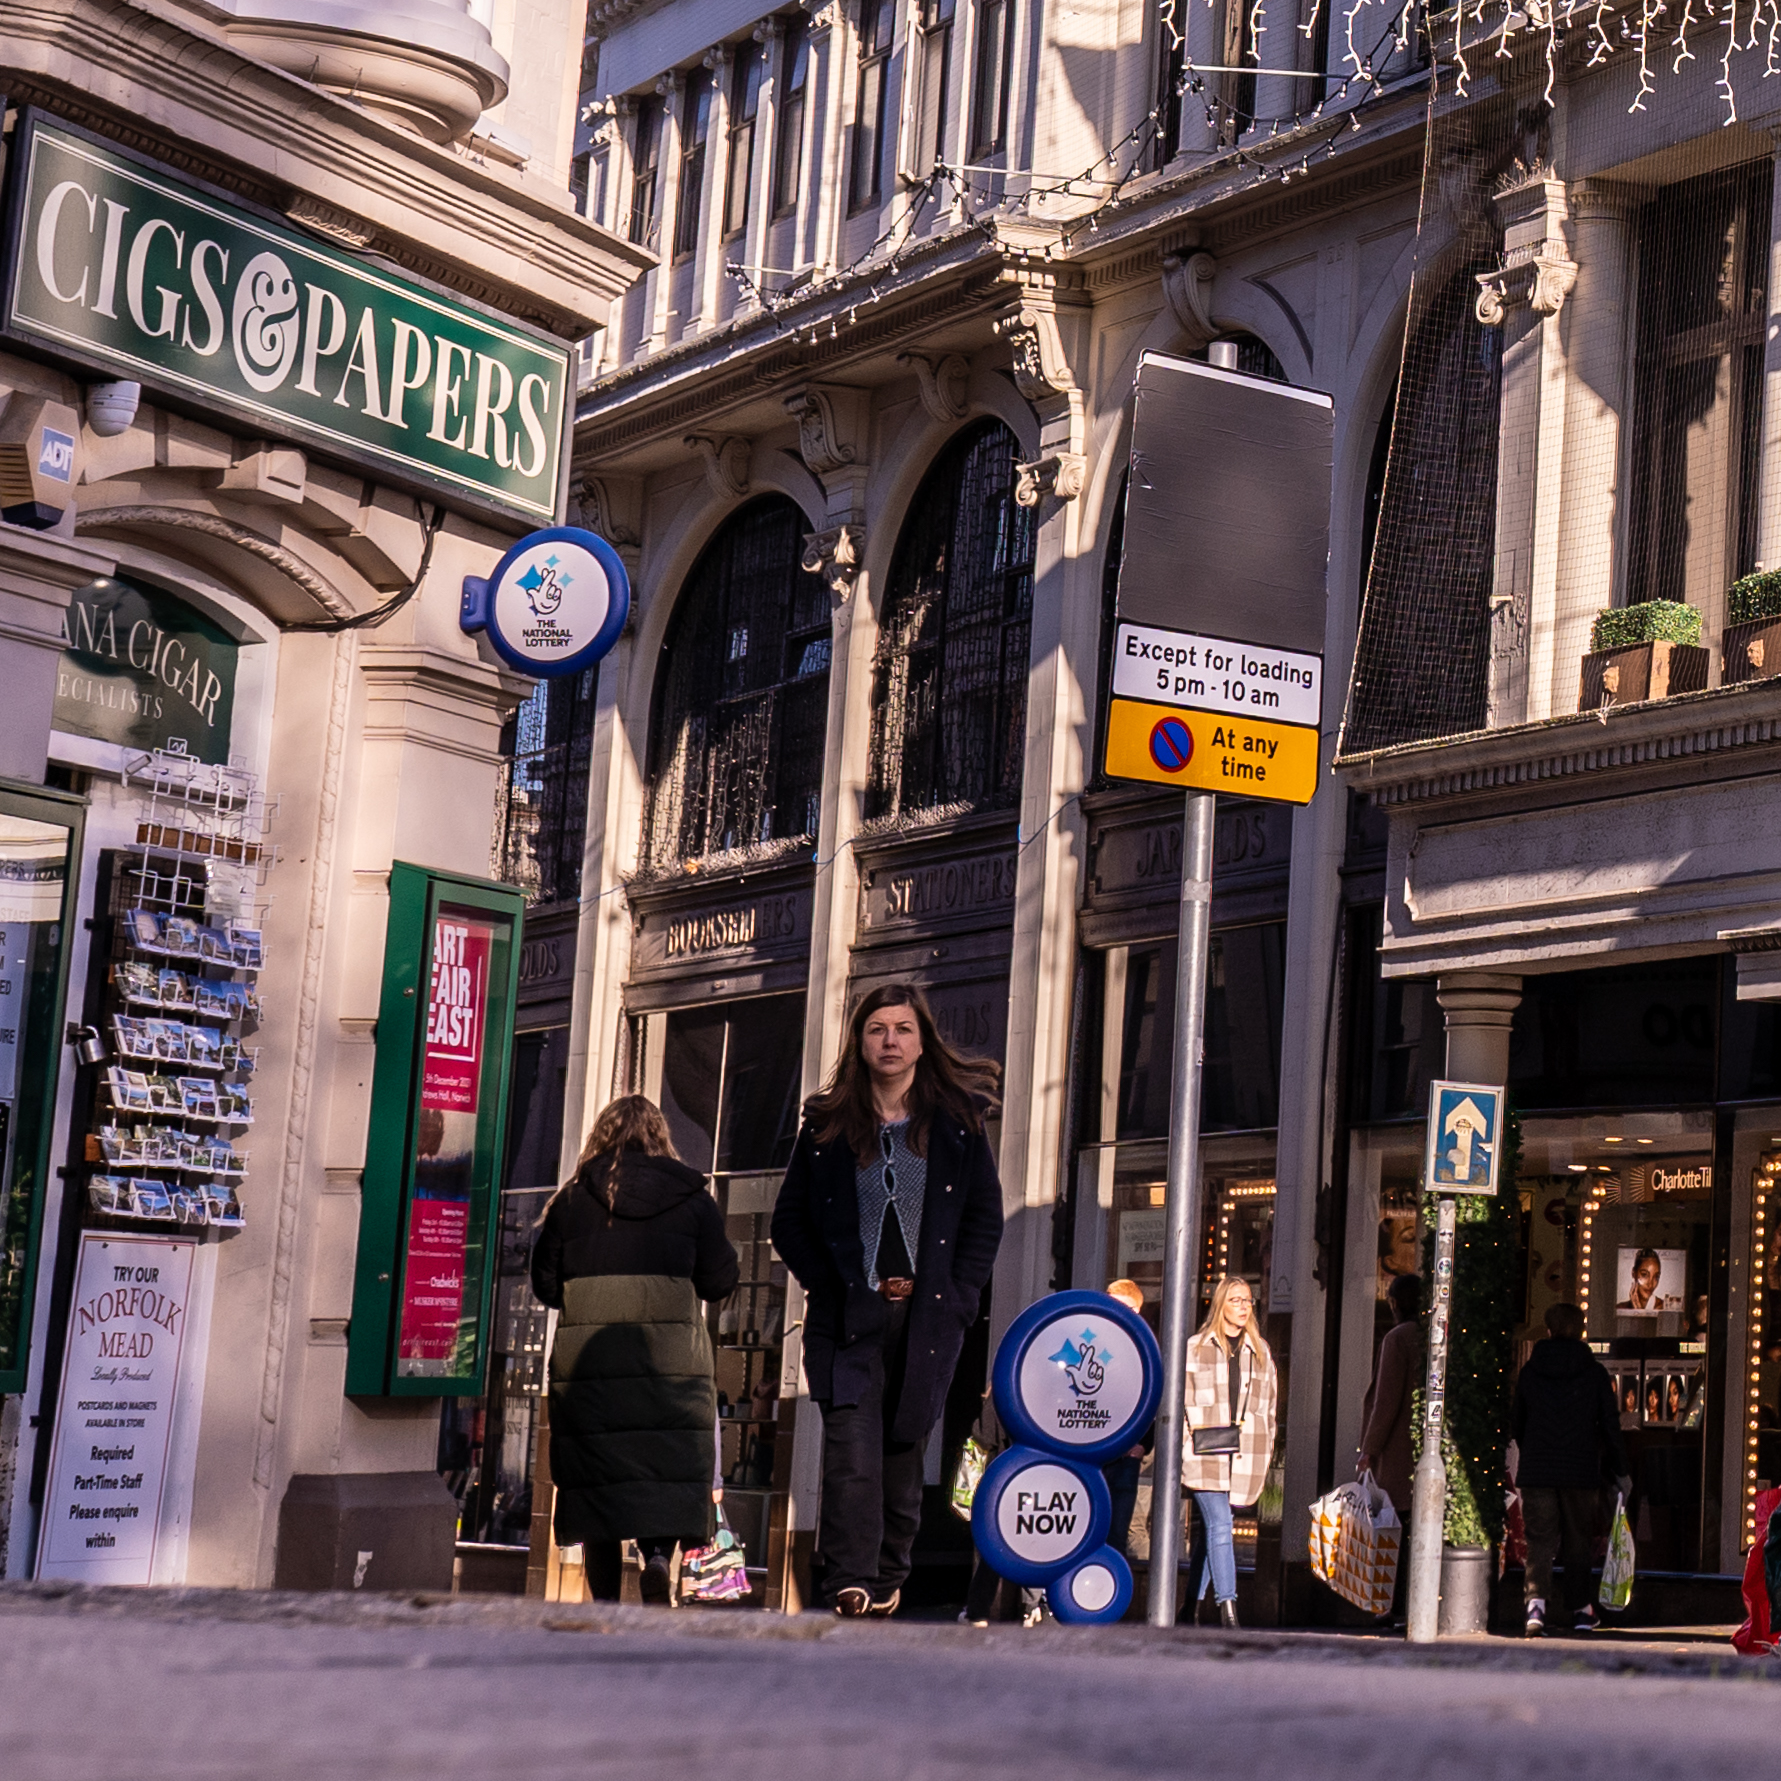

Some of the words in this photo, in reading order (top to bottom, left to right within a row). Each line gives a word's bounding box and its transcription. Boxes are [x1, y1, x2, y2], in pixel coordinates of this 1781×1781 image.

[36, 179, 230, 357] CIGS
[295, 282, 552, 479] PAPERS
[41, 440, 72, 472] ADT
[522, 628, 573, 638] NATIONAL
[537, 619, 556, 628] THE
[525, 638, 570, 648] LOTTERY
[128, 619, 222, 727] CIGAR
[1125, 635, 1197, 668] Except
[1204, 648, 1235, 674] for
[1241, 653, 1314, 690] loading
[1156, 668, 1169, 691] 5
[1172, 674, 1205, 700] pm
[1221, 678, 1247, 703] 10
[1250, 688, 1281, 709] am
[1211, 726, 1238, 751] At
[1243, 735, 1279, 760] any
[1221, 755, 1267, 781] time
[1137, 811, 1266, 877] JARLDS
[886, 853, 1016, 917] STATIONERS
[666, 895, 796, 956] BOOKSELLERS
[113, 1265, 133, 1283] TRY
[135, 1266, 160, 1283] OUR
[77, 1287, 183, 1337] NORFOLK
[97, 1331, 154, 1359] MEAD
[77, 1400, 114, 1412] POSTCARDS
[114, 1401, 129, 1411] AND
[129, 1401, 158, 1411] MAGNETS
[1057, 1409, 1112, 1420] NATIONAL
[1075, 1400, 1097, 1410] THE
[85, 1418, 118, 1429] AVAILABLE
[118, 1418, 126, 1428] IN
[126, 1418, 146, 1429] STORE
[1058, 1419, 1108, 1429] LOTTERY
[90, 1445, 134, 1465] Required
[73, 1474, 119, 1491] Part-Time
[119, 1473, 144, 1490] Staff
[1017, 1491, 1078, 1512] PLAY
[69, 1503, 101, 1521] Please
[103, 1504, 139, 1523] enquire
[1015, 1514, 1078, 1536] NOW
[85, 1532, 116, 1549] within
